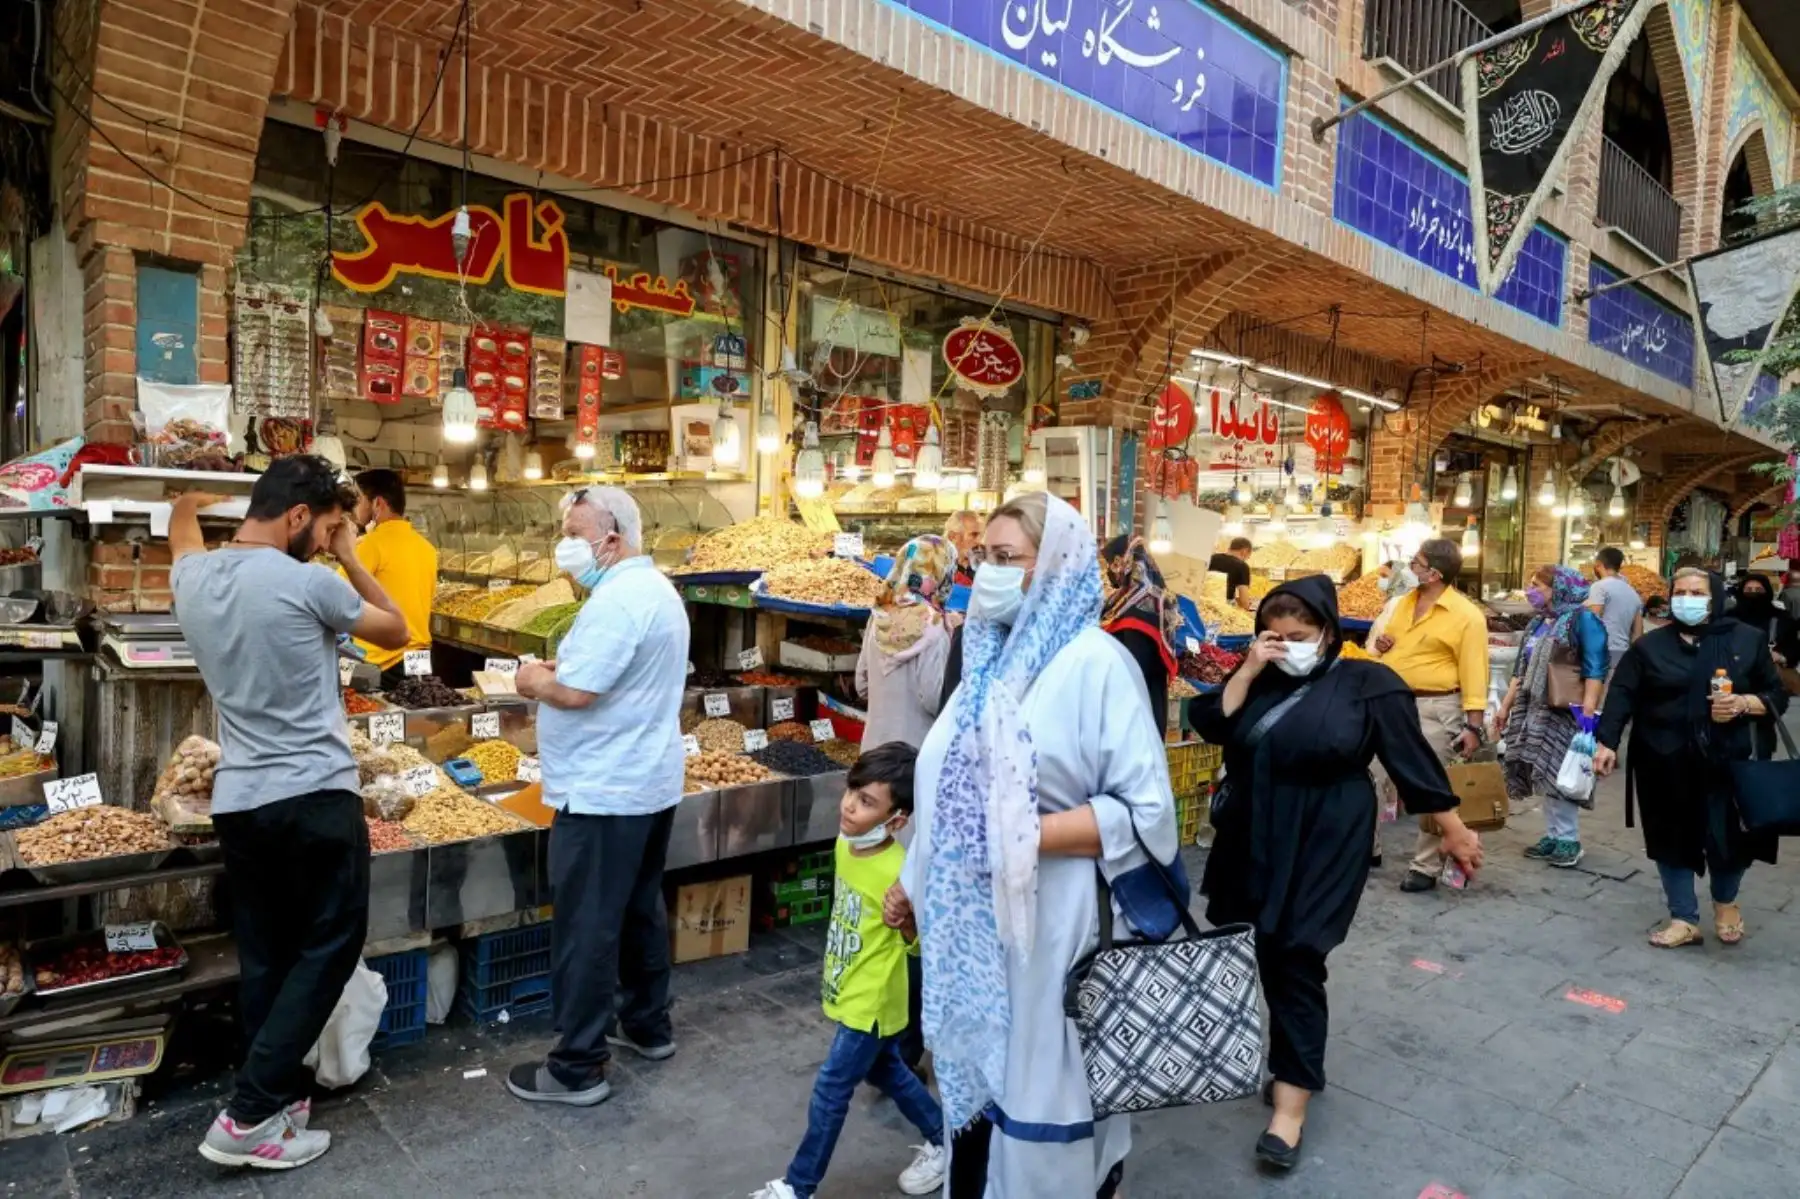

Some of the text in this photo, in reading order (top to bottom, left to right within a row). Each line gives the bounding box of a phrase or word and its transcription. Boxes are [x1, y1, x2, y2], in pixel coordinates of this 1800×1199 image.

[1081, 0, 1206, 112] فروشگاه
[333, 193, 570, 298] ناصر
[1408, 195, 1440, 251] خرداد
[604, 264, 696, 317] خشکبا
